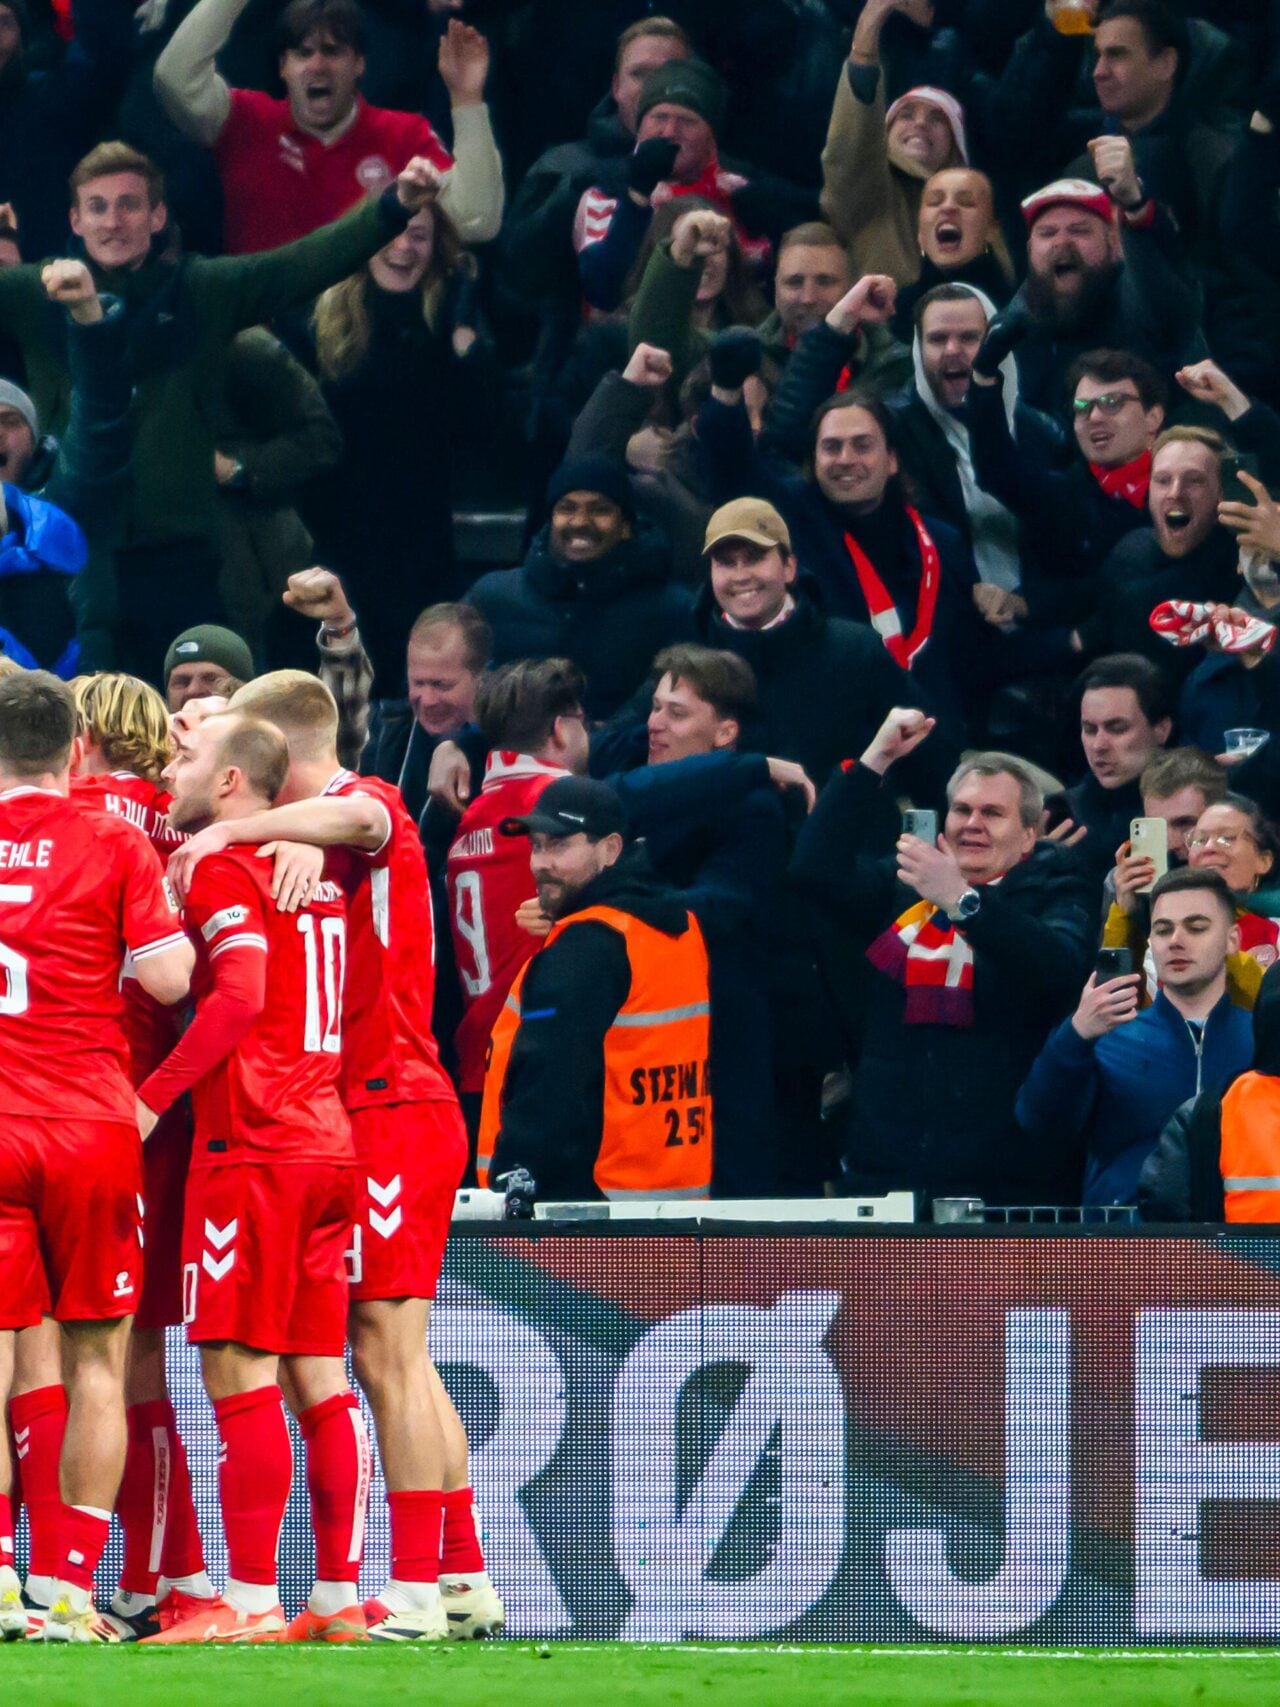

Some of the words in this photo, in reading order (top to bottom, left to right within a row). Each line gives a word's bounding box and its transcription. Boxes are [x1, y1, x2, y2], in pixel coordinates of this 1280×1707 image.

[296, 912, 348, 1055] 10
[455, 870, 492, 997] 9
[664, 1105, 705, 1148] 25
[165, 1288, 1280, 1642] RØJE
